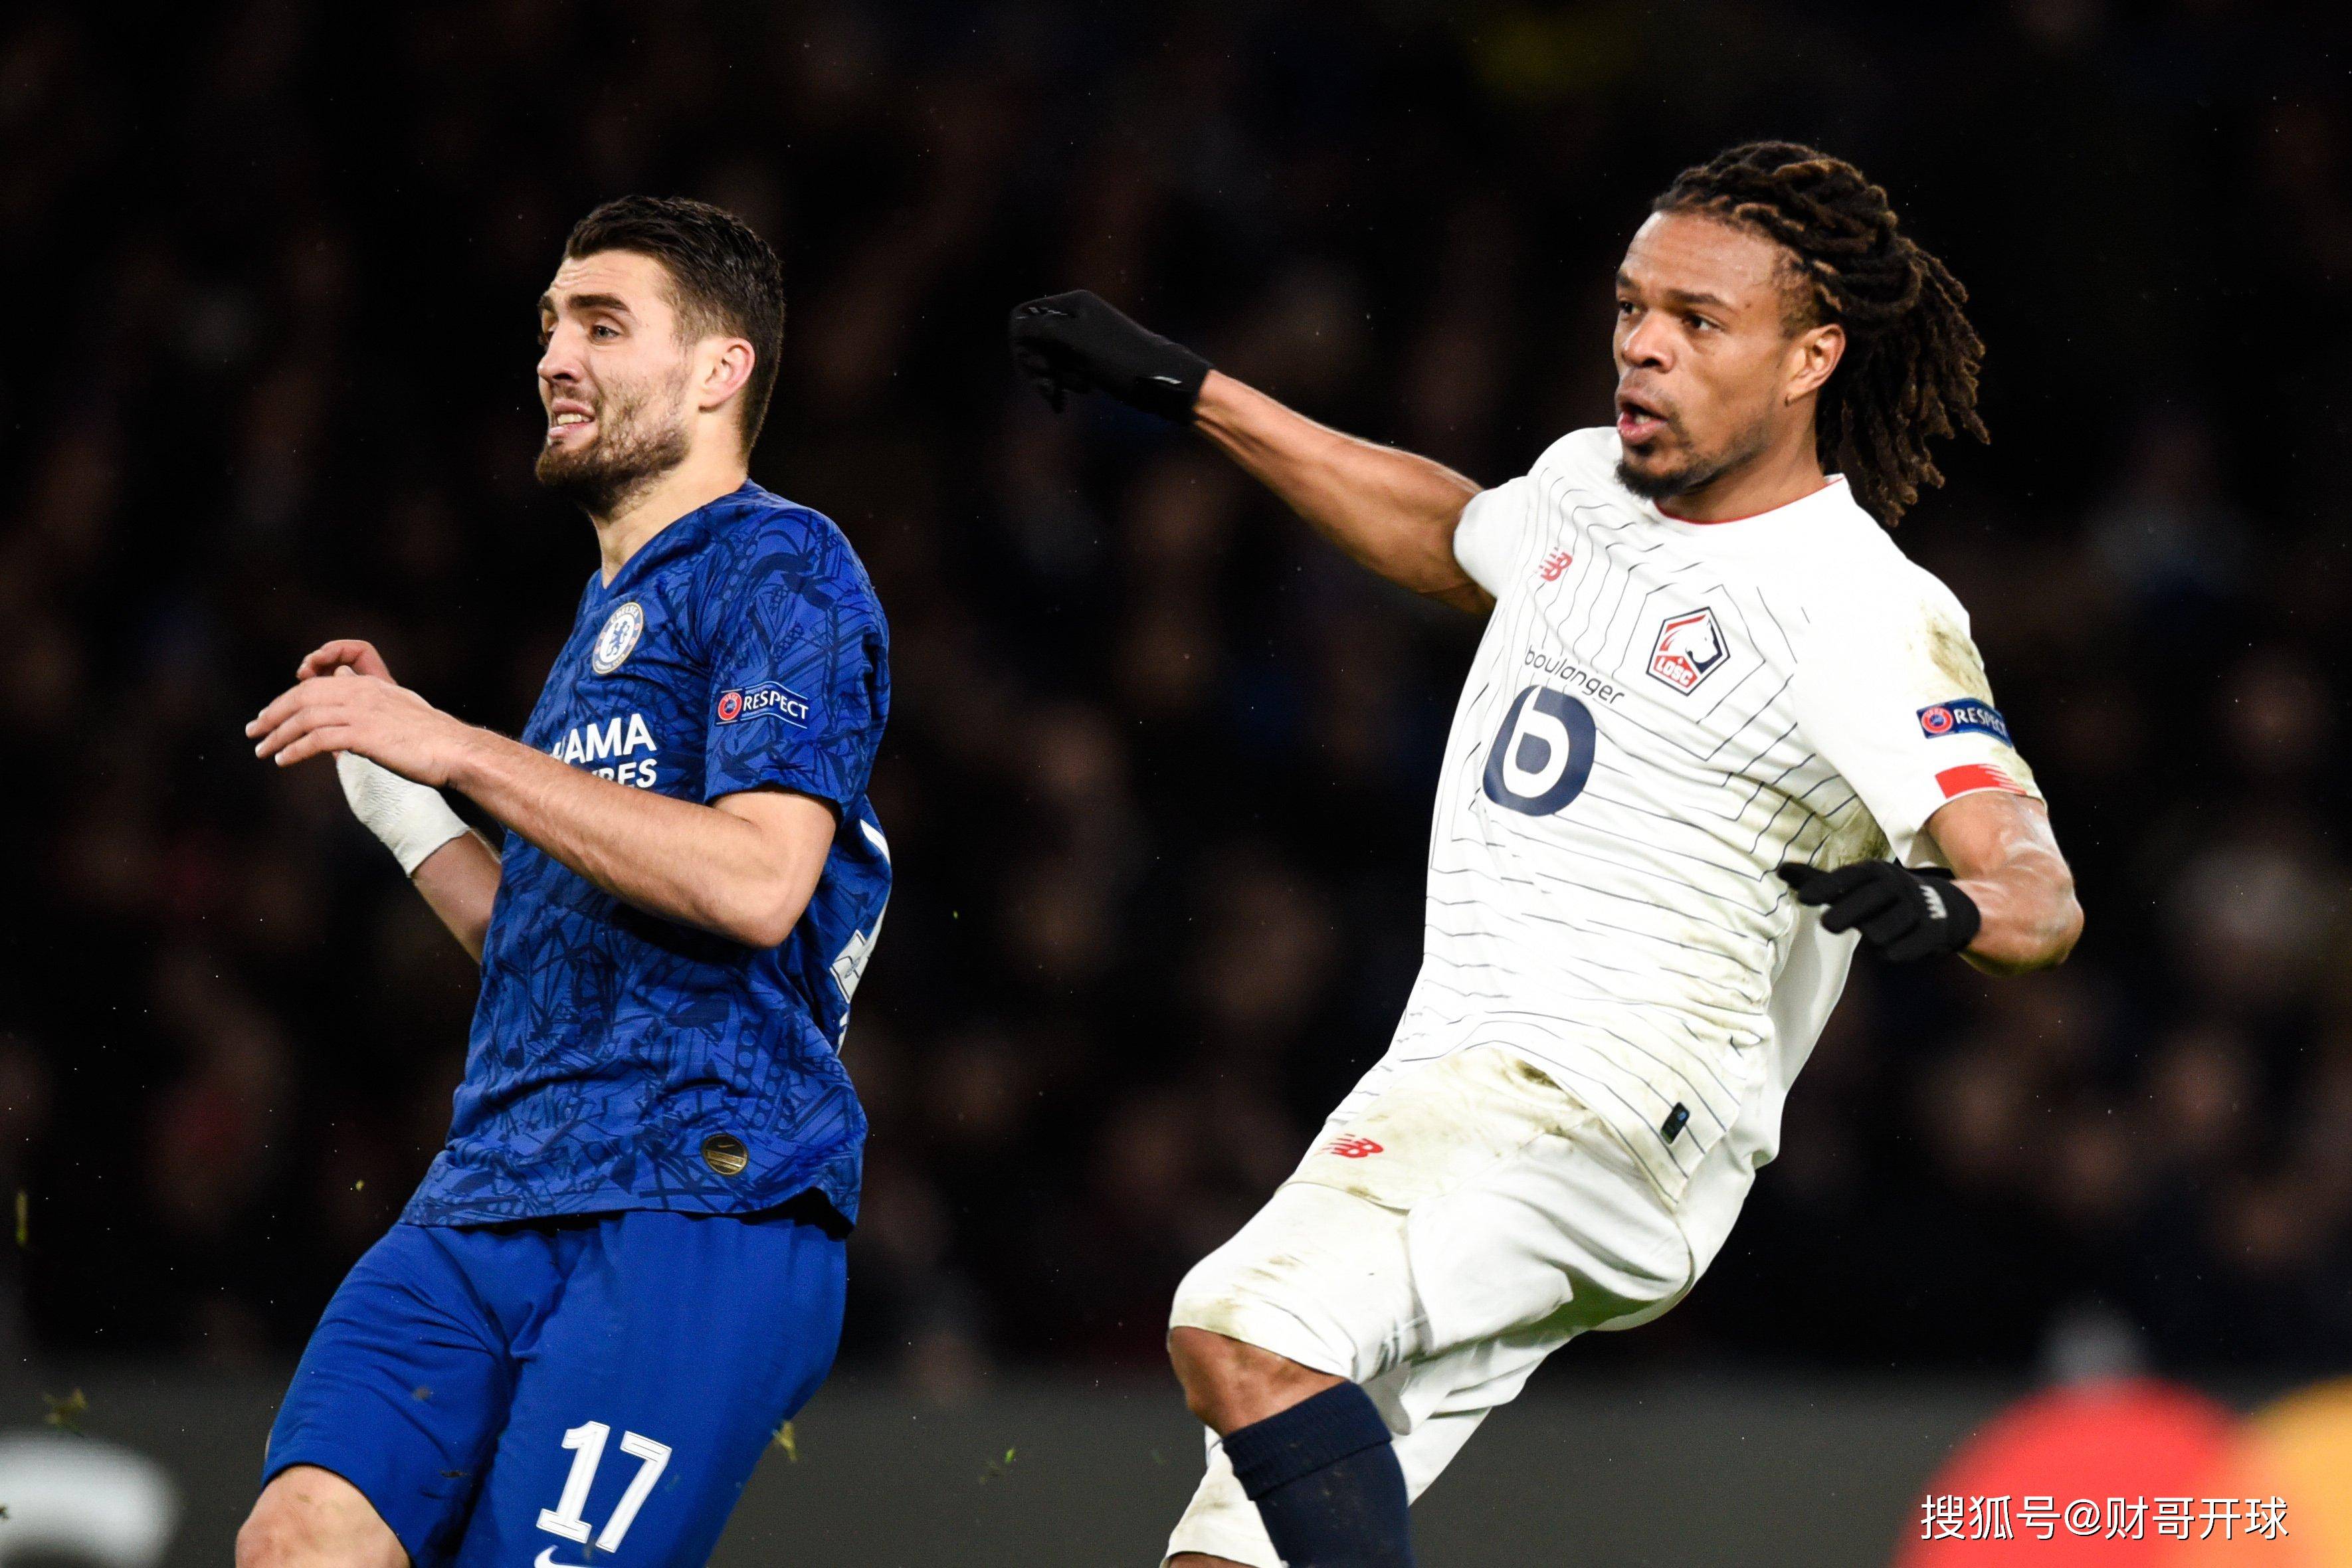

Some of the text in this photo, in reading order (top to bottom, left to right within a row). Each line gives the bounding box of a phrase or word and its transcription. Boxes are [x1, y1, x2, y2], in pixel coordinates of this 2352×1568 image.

[1525, 644, 1624, 704] boulanger
[1656, 656, 1694, 685] LOSC
[743, 690, 809, 720] RESPECT
[536, 1421, 672, 1553] 17
